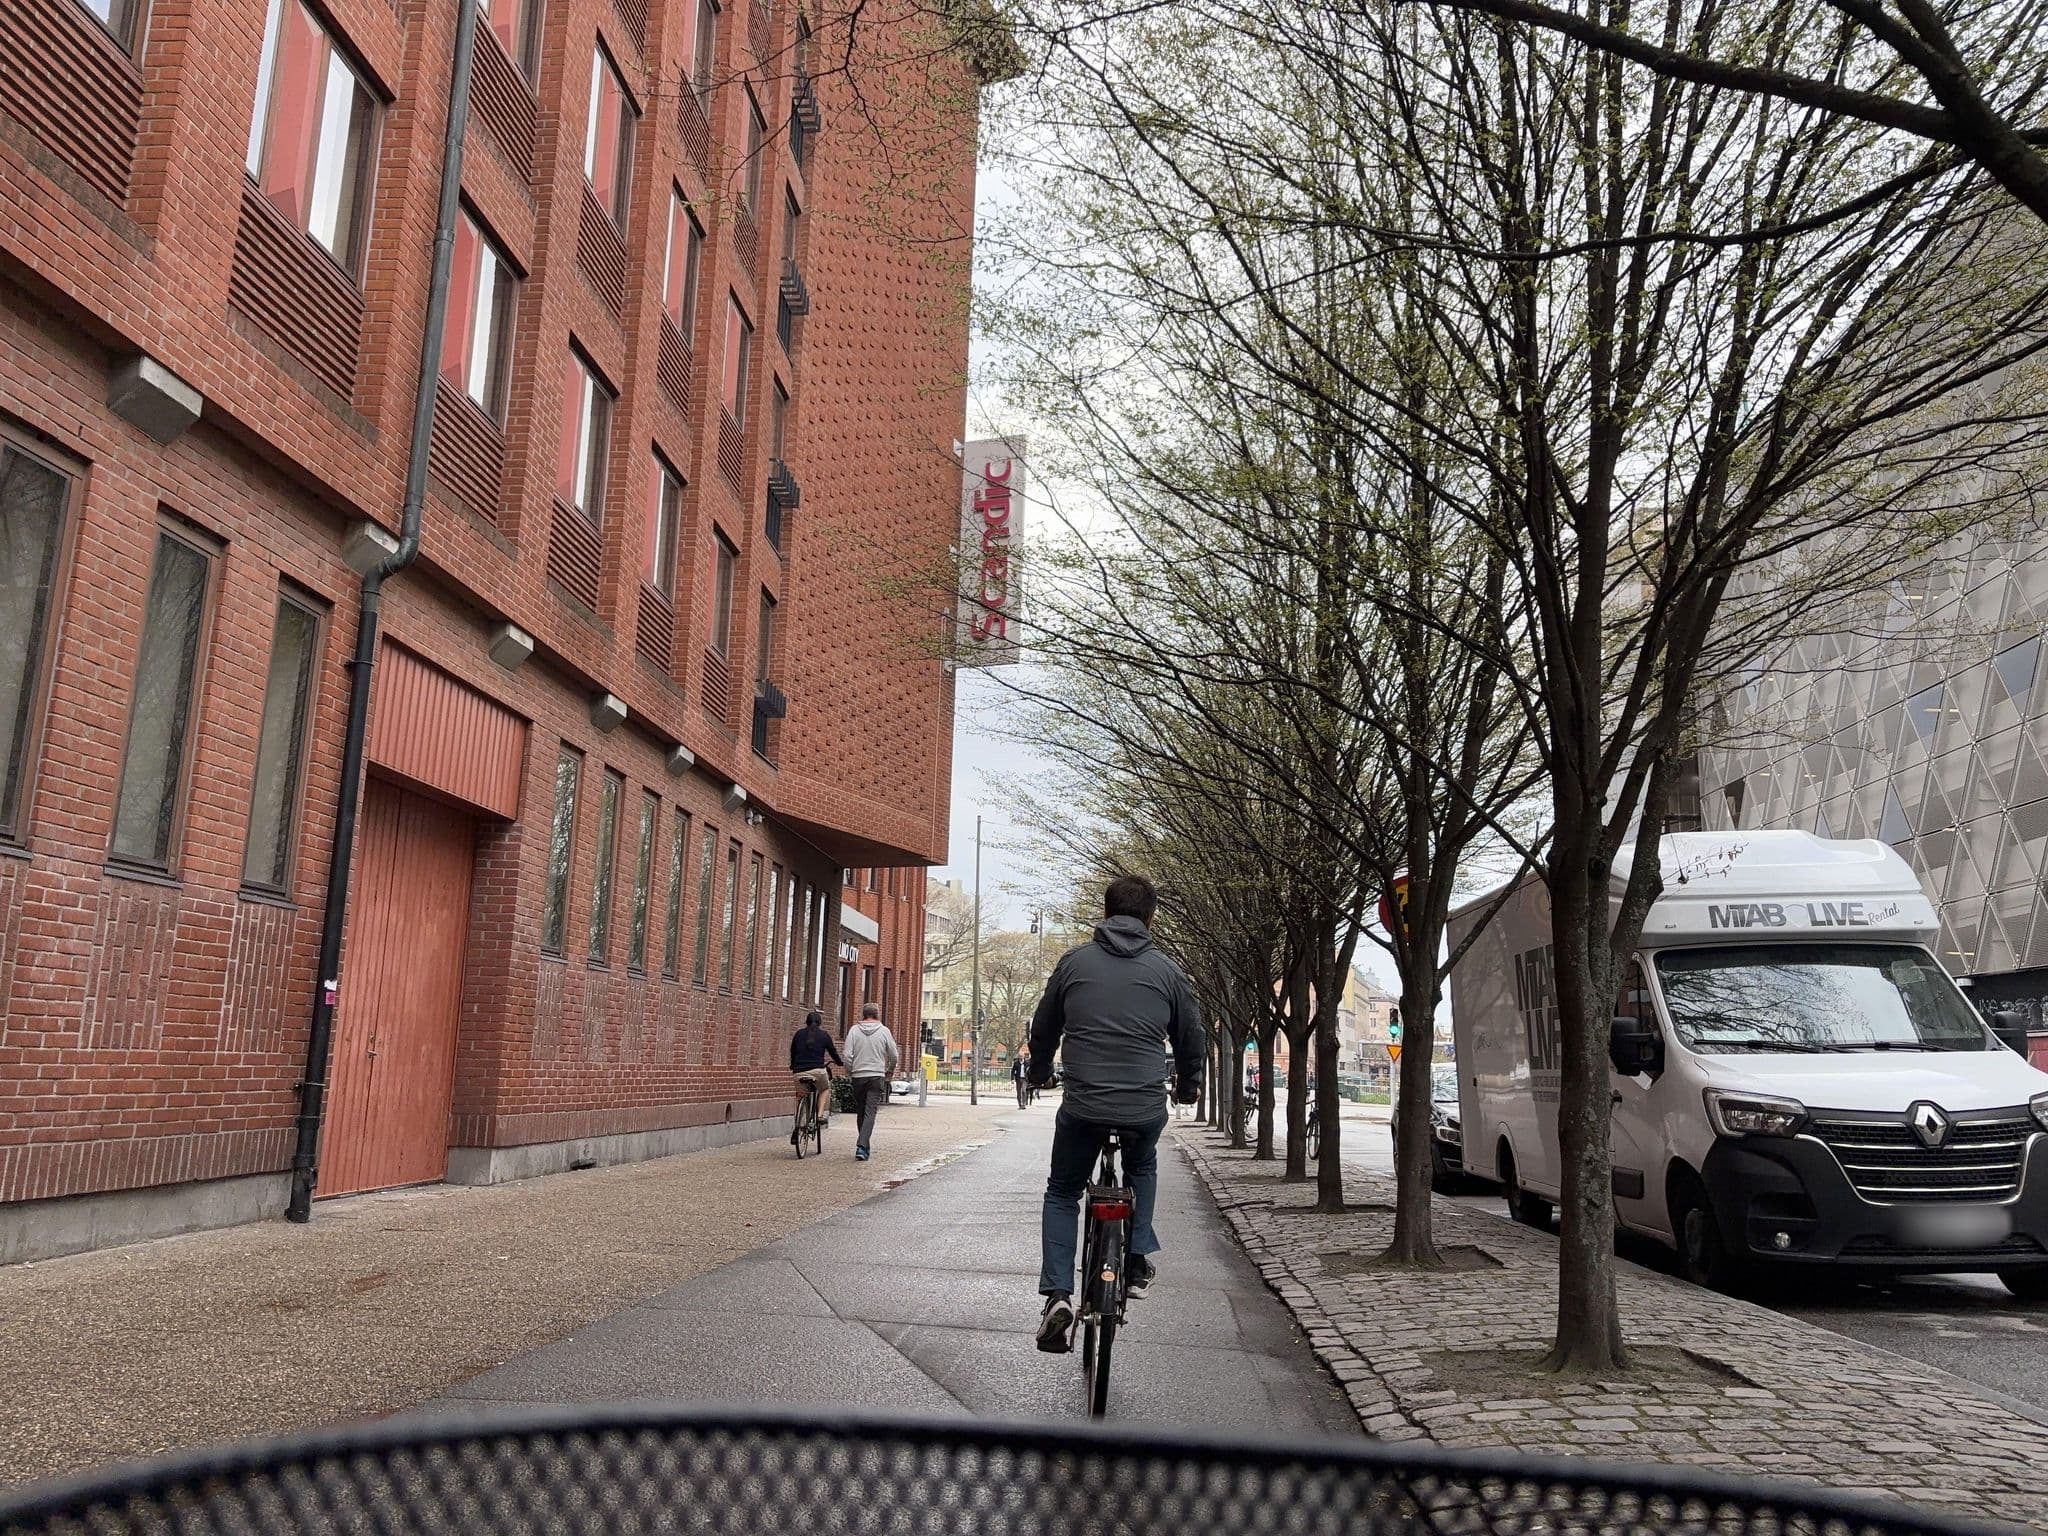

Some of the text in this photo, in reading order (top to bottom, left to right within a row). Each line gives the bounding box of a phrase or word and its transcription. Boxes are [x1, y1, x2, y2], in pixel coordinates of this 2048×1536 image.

[970, 460, 1012, 641] Scandic
[1708, 902, 1900, 929] MTAB LIVE Rental
